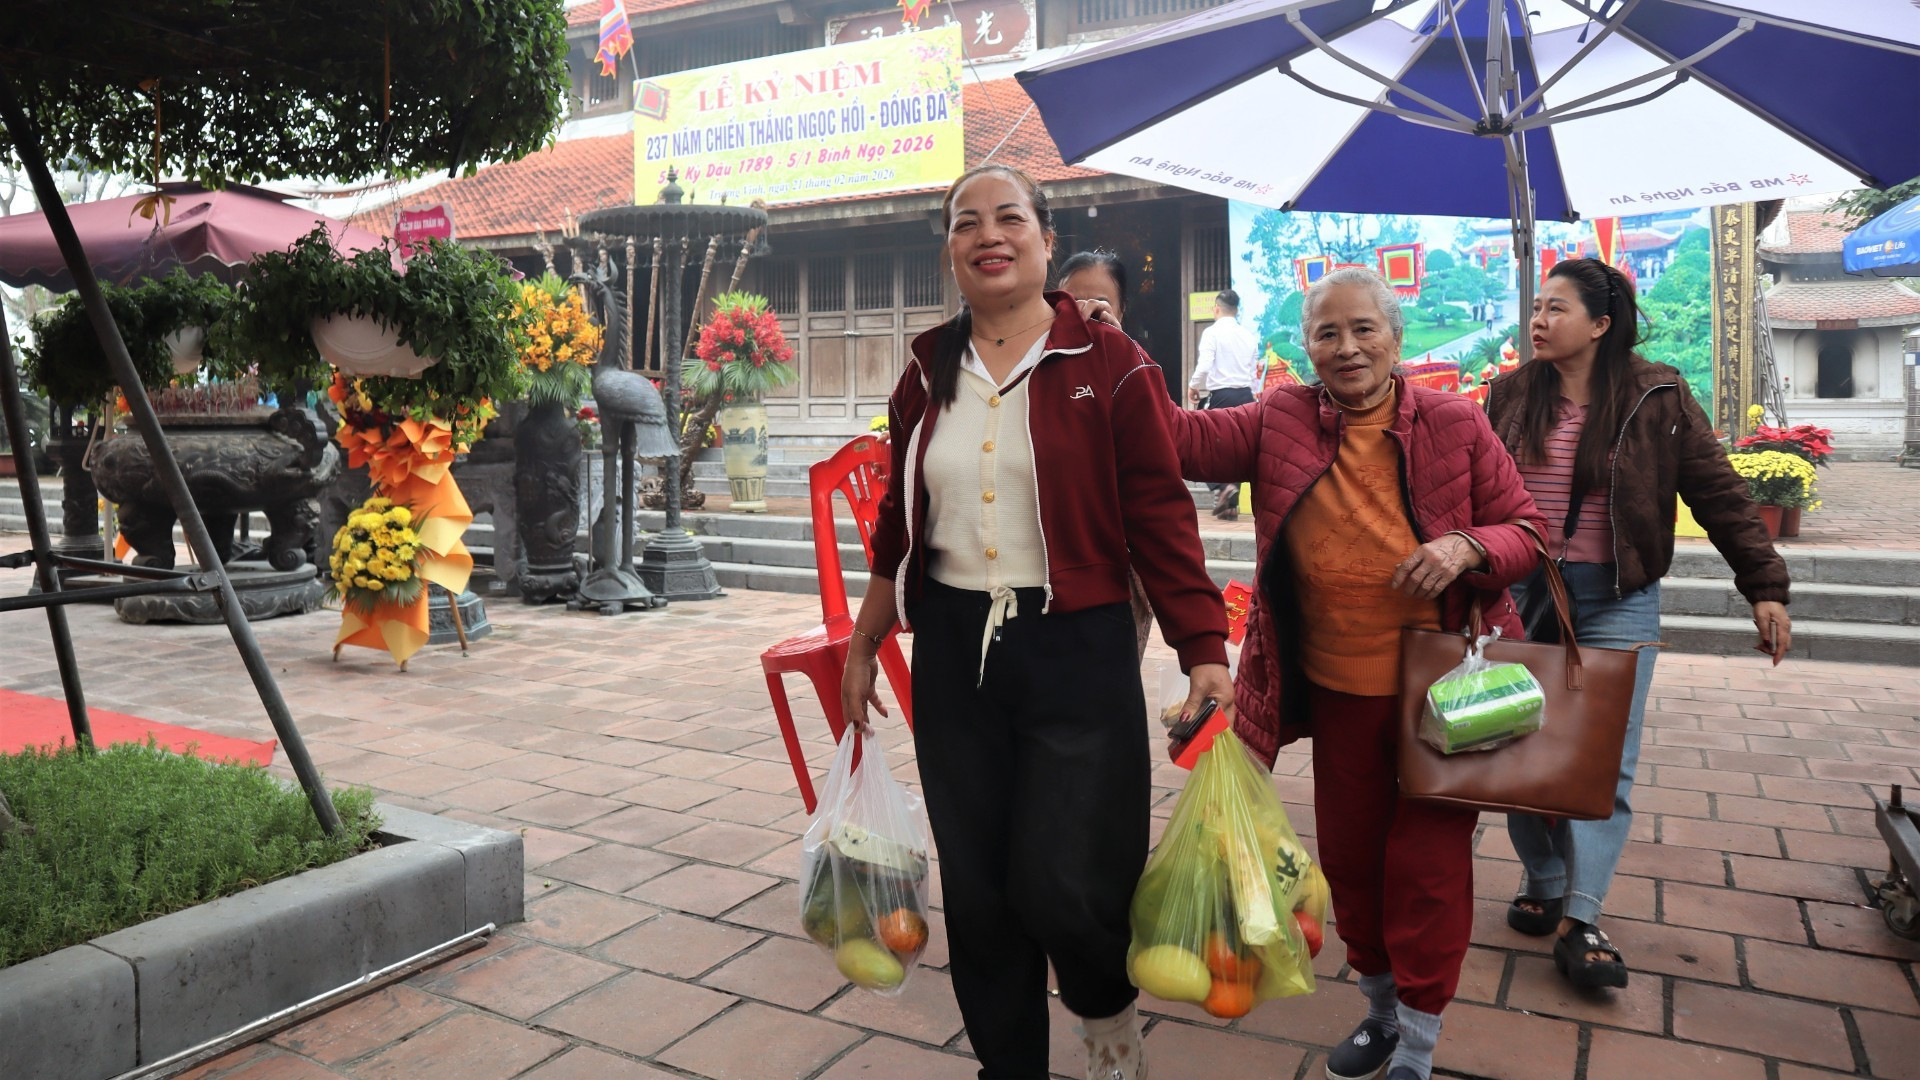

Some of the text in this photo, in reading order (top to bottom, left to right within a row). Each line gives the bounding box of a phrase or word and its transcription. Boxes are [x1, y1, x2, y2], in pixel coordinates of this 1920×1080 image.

[699, 60, 882, 112] LỄ KỶ NIỆM
[647, 135, 668, 160] 237
[673, 126, 702, 157] NĂM
[706, 116, 745, 152] CHIẾN
[749, 109, 793, 146] THẮNG
[798, 109, 836, 143] NGỌC
[880, 89, 922, 128] ĐỐNG
[926, 93, 948, 122] ĐA
[706, 161, 732, 182] Dậu
[738, 155, 773, 174] 1789
[787, 151, 812, 168] 5/1
[857, 143, 886, 162] Ngọ
[891, 134, 935, 155] 2026
[805, 174, 831, 189] tháng
[834, 173, 846, 185] 02
[848, 172, 869, 184] năm
[872, 168, 895, 181] 2026
